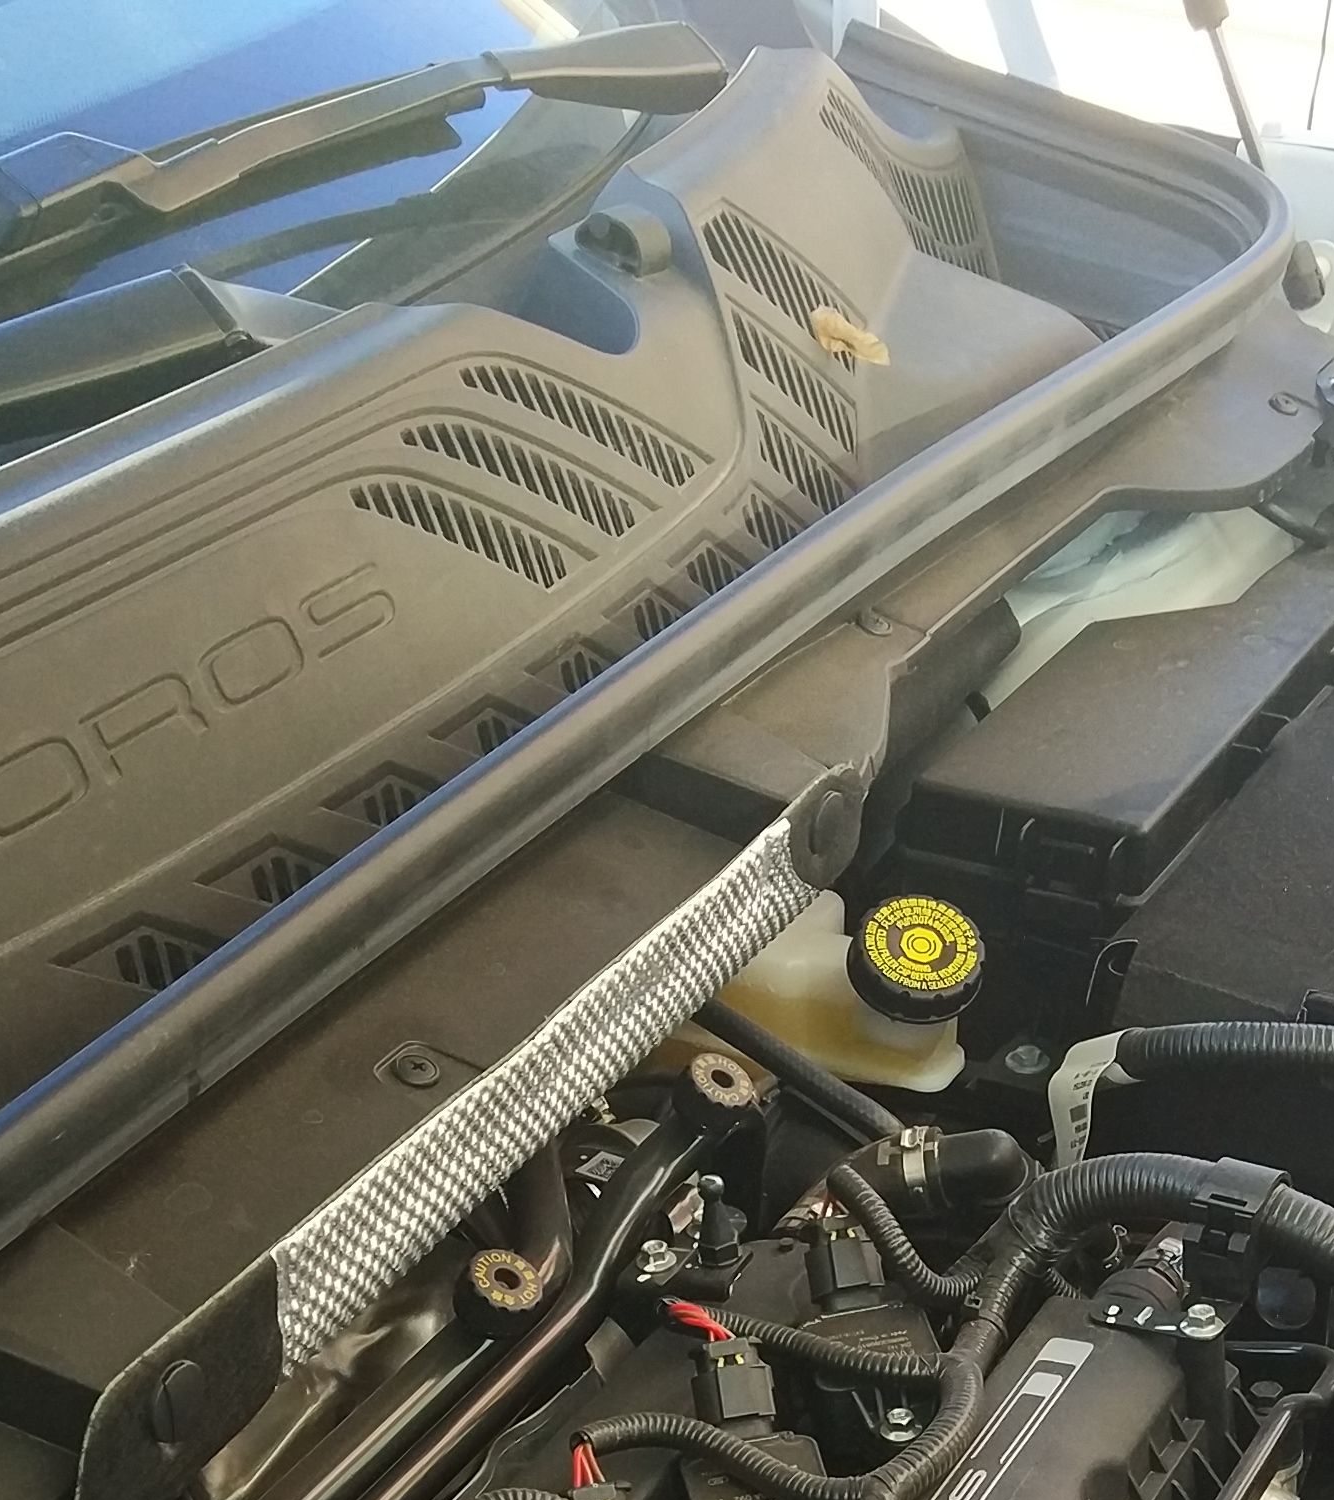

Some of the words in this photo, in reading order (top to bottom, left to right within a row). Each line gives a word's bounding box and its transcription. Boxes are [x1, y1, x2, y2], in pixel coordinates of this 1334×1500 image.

[879, 964, 898, 981] FLUID
[898, 976, 921, 989] FROM
[921, 981, 927, 989] A
[927, 977, 955, 989] SEALED
[695, 1069, 738, 1101] CAUTION
[474, 1253, 510, 1288] CAUTION
[518, 1282, 537, 1304] HOT
